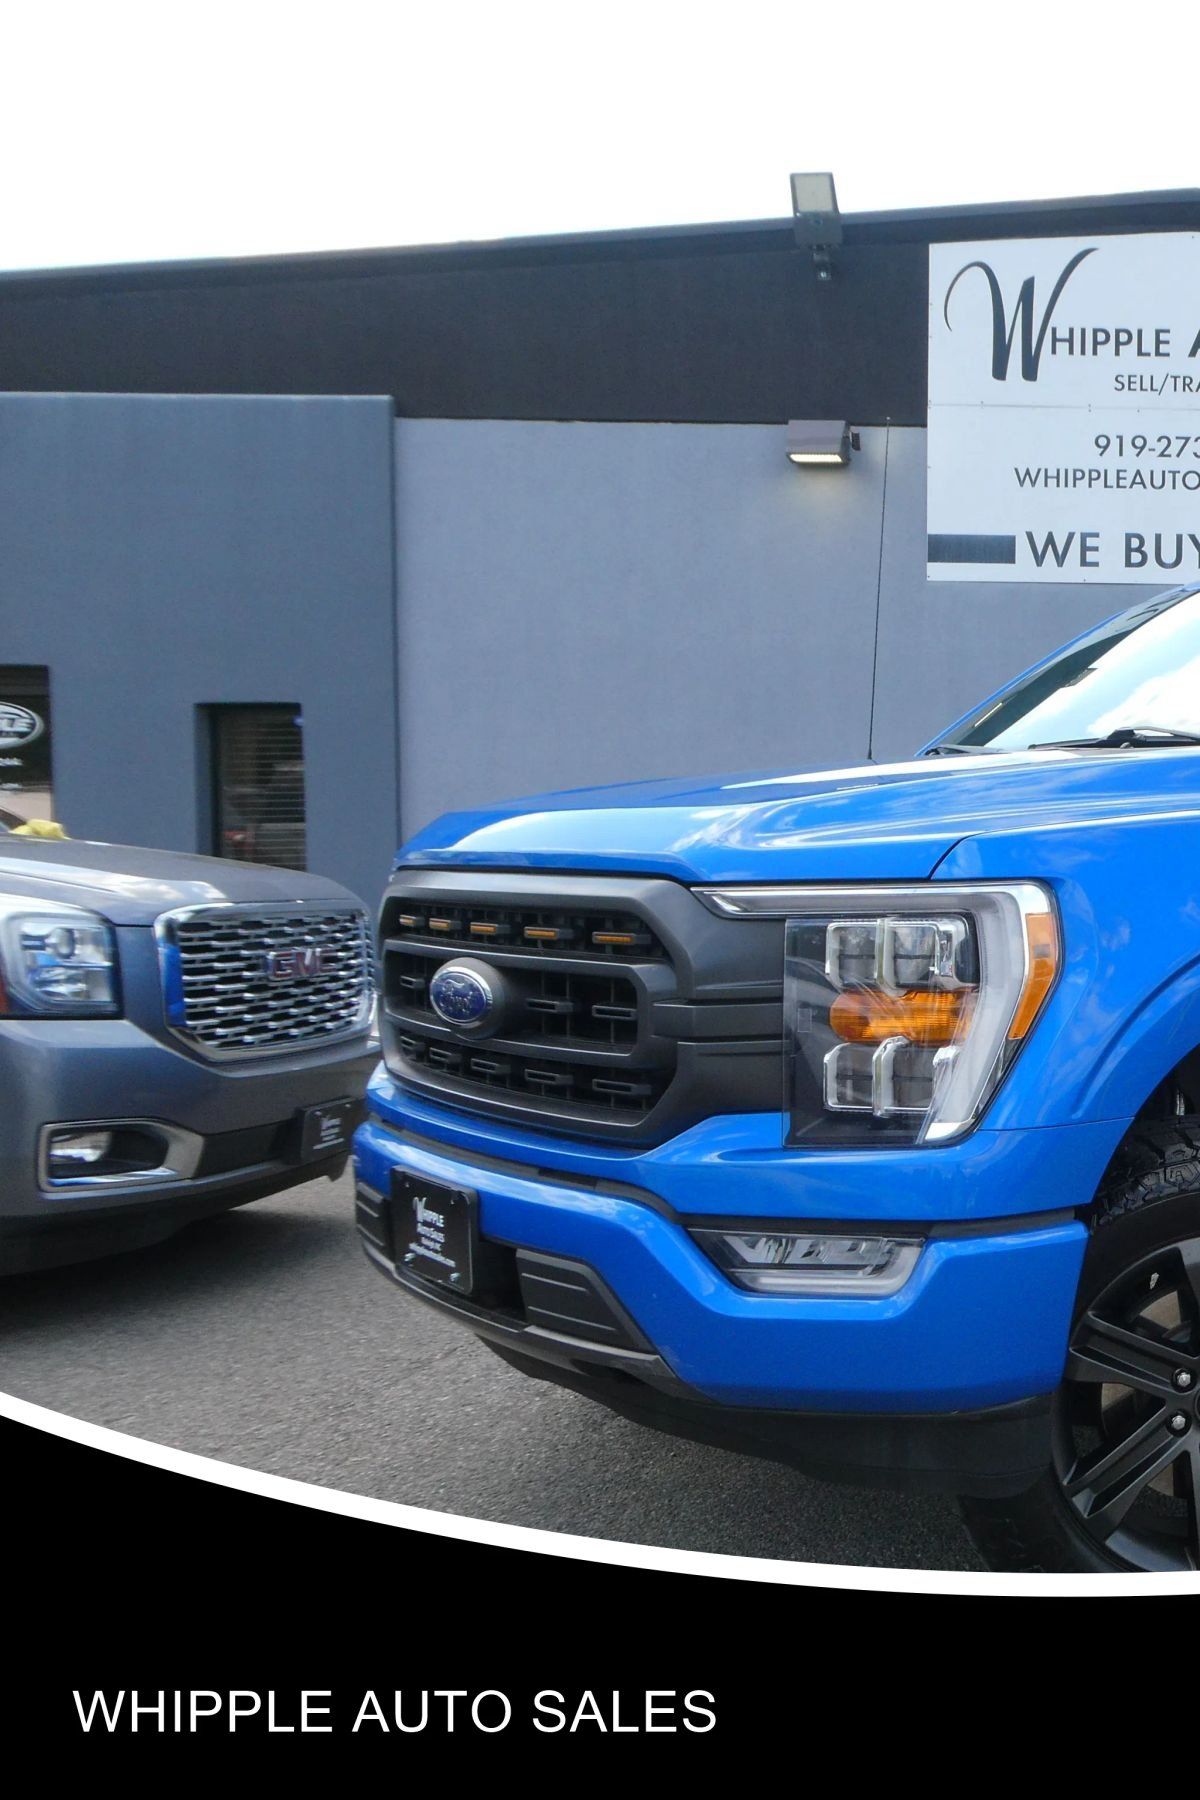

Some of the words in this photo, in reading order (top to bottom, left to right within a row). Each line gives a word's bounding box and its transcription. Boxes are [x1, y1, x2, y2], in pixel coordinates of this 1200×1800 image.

[943, 247, 1171, 382] WHIPPLE
[1025, 531, 1100, 568] WE
[270, 947, 336, 980] GMC
